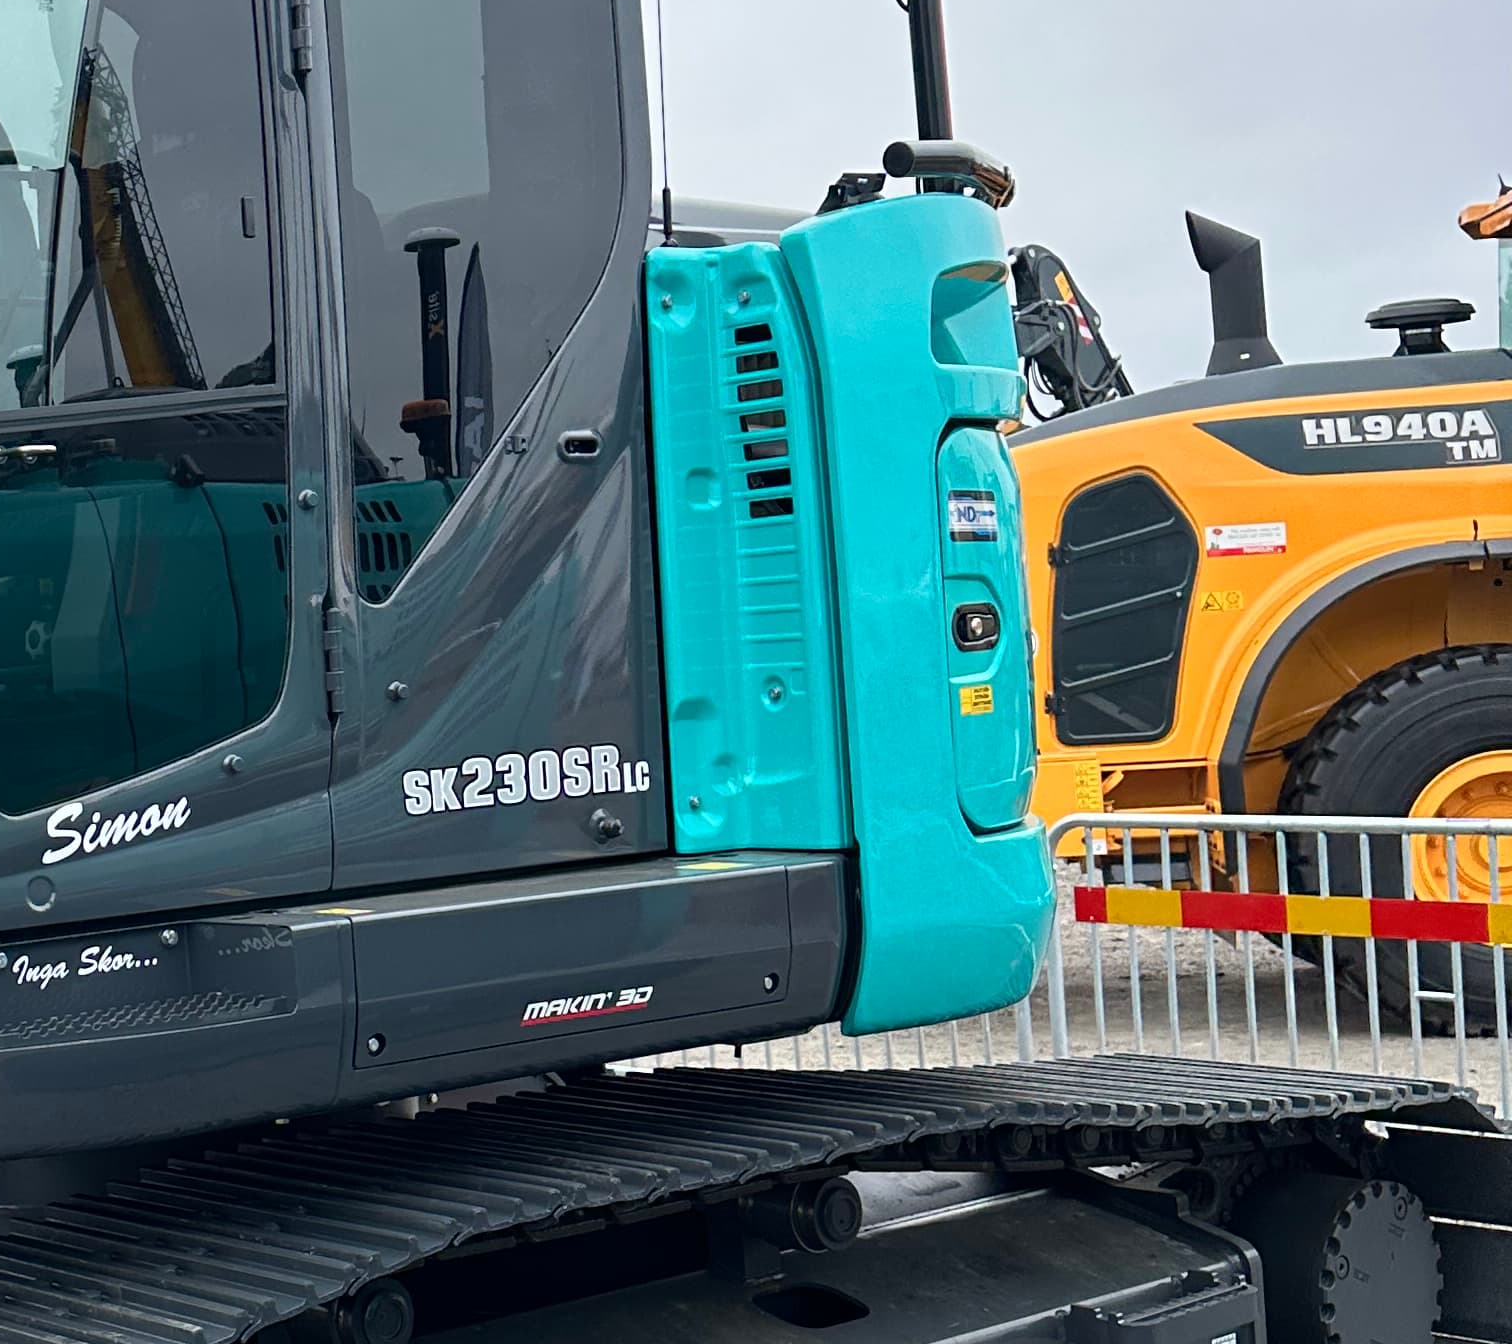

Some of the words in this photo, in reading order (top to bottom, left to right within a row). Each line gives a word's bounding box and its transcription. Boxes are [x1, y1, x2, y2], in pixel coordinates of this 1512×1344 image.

[1301, 409, 1494, 446] HL940A
[1445, 438, 1498, 460] TM
[41, 796, 191, 865] Simon
[12, 954, 70, 990] Inga
[615, 986, 654, 1007] 3D
